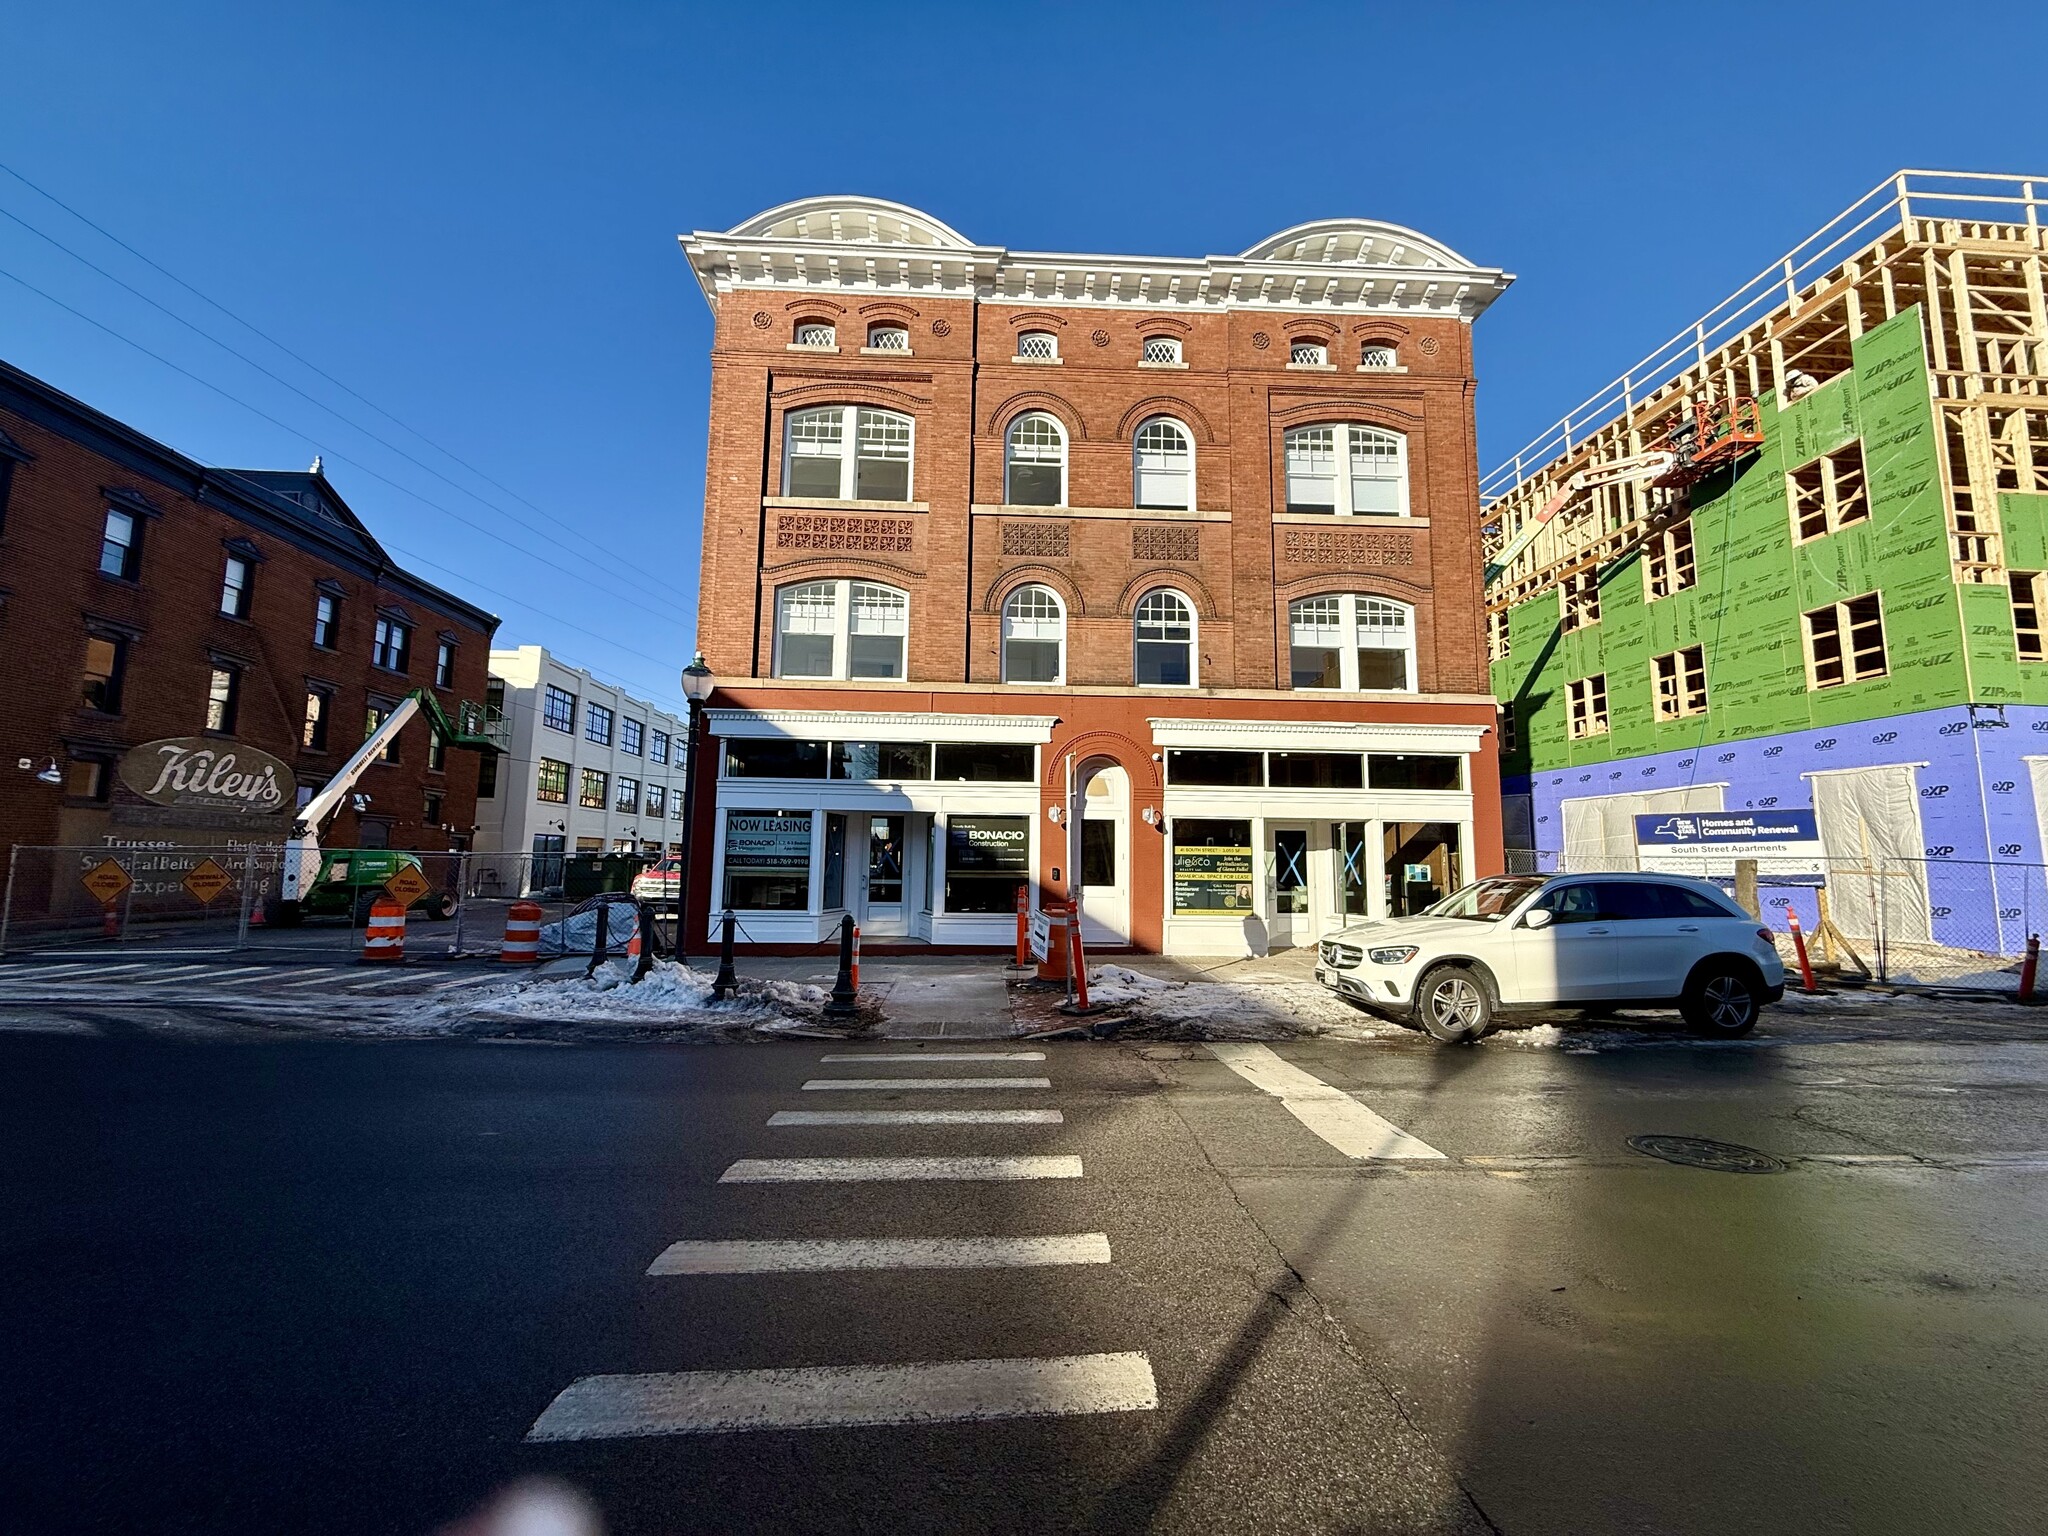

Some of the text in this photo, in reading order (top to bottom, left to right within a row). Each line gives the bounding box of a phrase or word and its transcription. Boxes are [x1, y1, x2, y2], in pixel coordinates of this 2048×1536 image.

[1939, 722, 1968, 734] eXP
[1872, 732, 1897, 743] eXP
[1815, 738, 1837, 749] eXP
[1764, 746, 1783, 756] eXP
[1718, 752, 1736, 762] eXP
[1678, 759, 1693, 767] eXP
[1642, 767, 1656, 775] eXP
[145, 745, 282, 813] Kiley's
[1921, 785, 1949, 796] eXP
[1992, 781, 2015, 791] eXP
[1759, 797, 1778, 806] eXP
[730, 820, 811, 832] NOW LEASING
[1702, 818, 1753, 827] Homes and
[969, 831, 1024, 840] BONACIO
[1703, 825, 1798, 836] Community Renewal
[1671, 844, 1787, 854] South Street Apartments
[1925, 846, 1954, 856] eXP
[1998, 844, 2021, 854] eXP
[159, 857, 195, 870] Belts
[1769, 898, 1789, 906] eXP
[1930, 907, 1951, 916] XP
[2000, 908, 2021, 918] eXP
